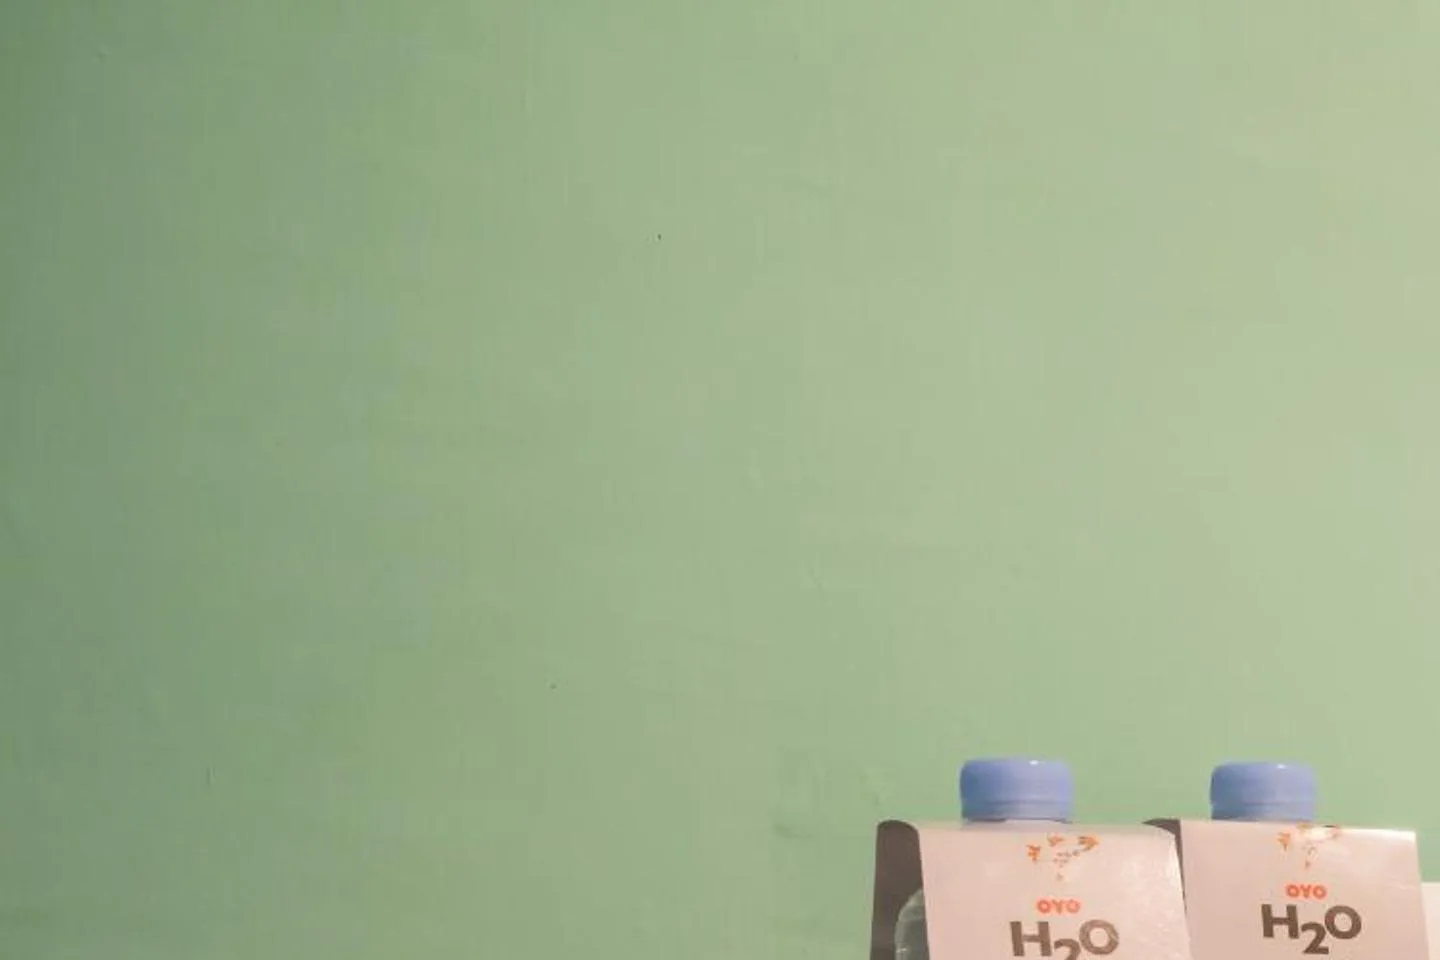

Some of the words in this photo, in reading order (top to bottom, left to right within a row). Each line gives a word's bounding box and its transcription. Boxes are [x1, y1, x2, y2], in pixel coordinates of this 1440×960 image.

[1285, 884, 1327, 899] OYO
[1036, 899, 1081, 914] OYO
[1260, 903, 1362, 955] H2O
